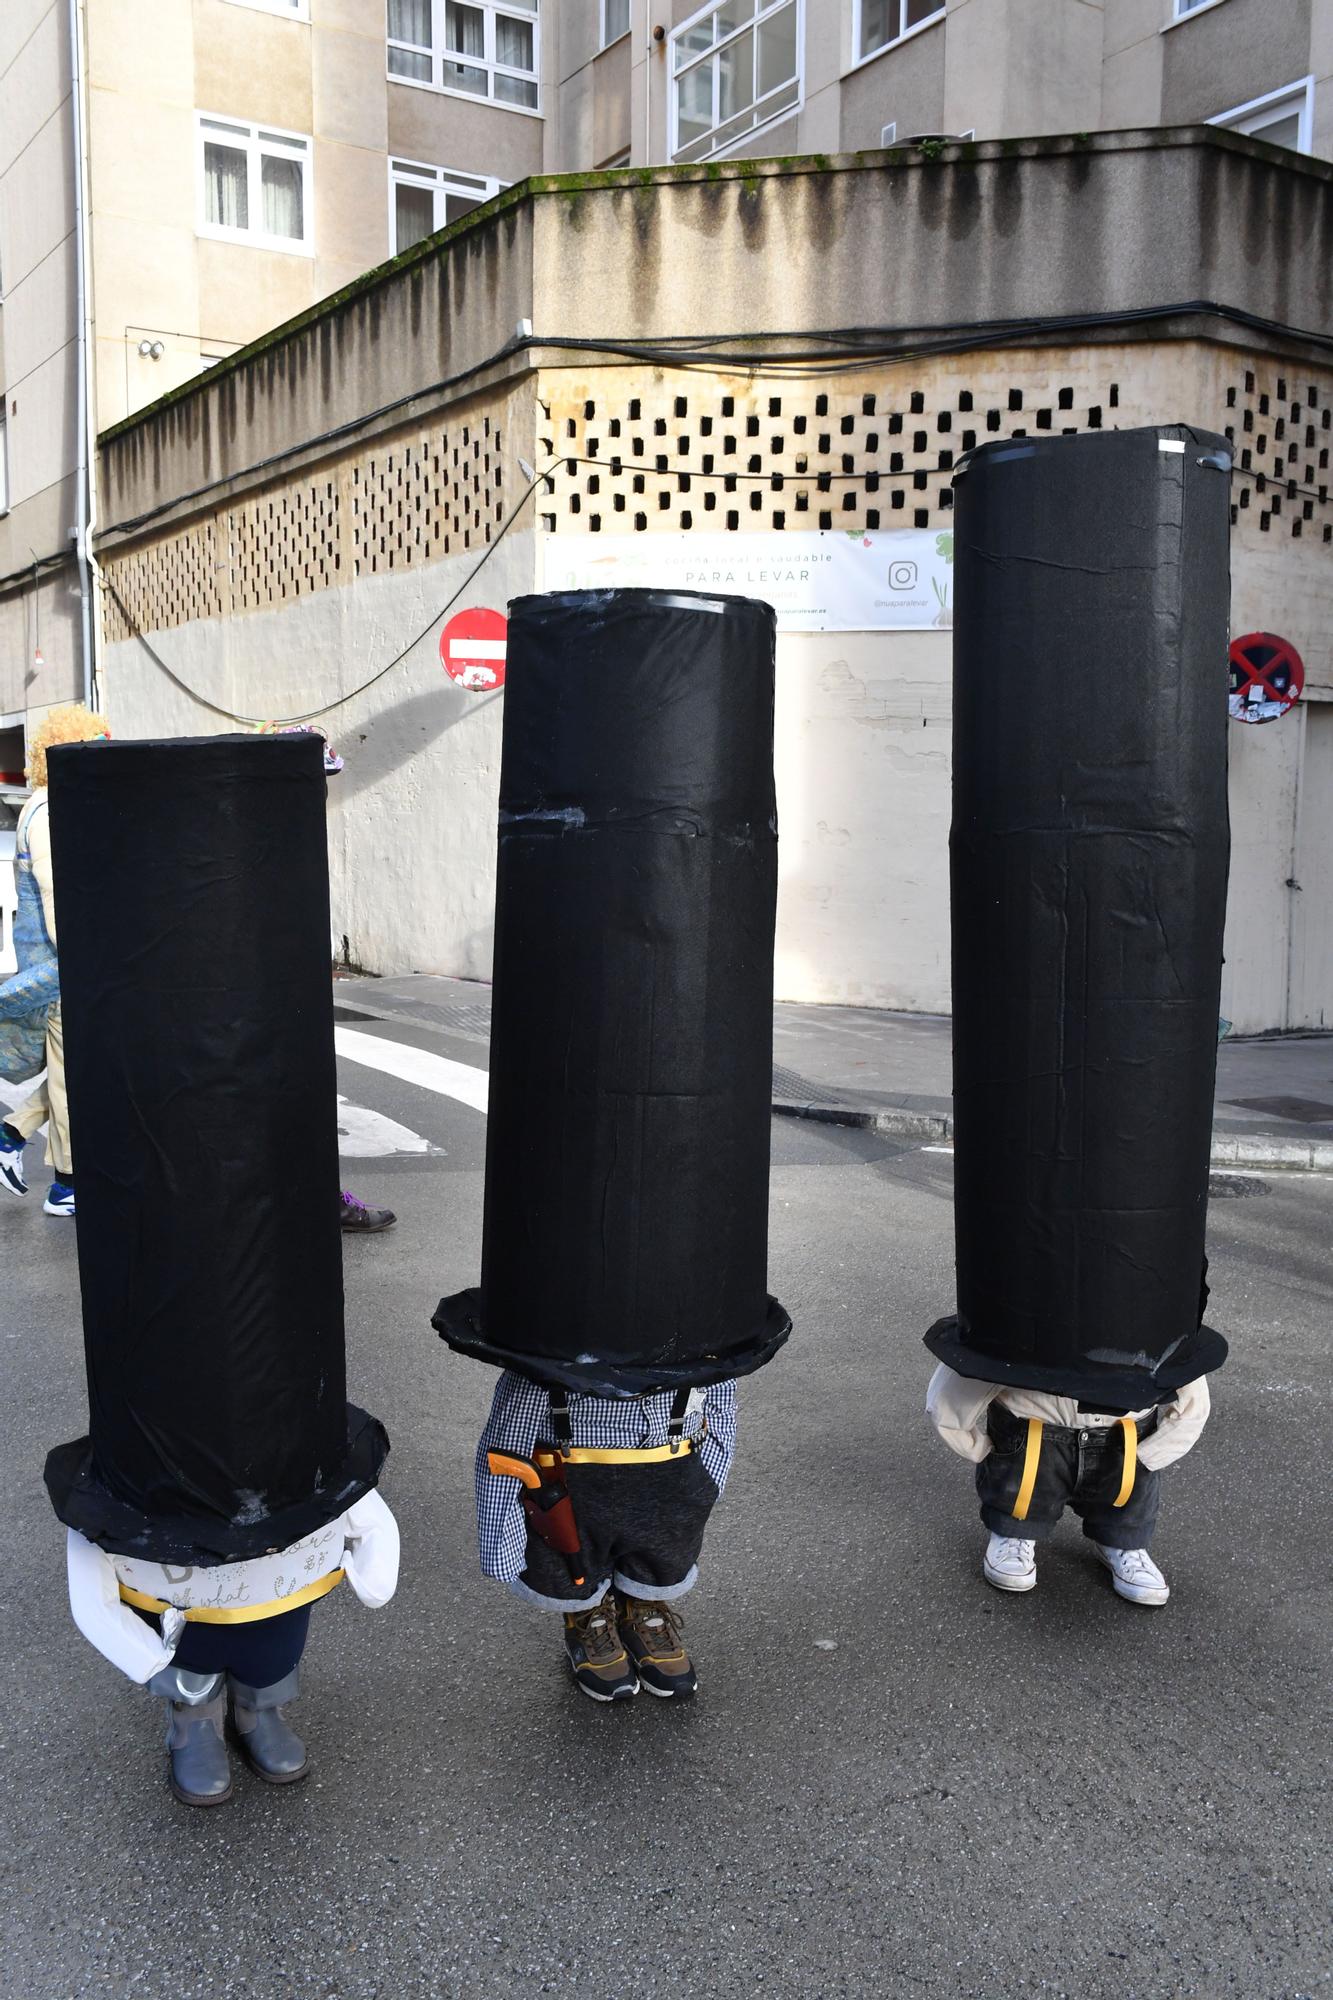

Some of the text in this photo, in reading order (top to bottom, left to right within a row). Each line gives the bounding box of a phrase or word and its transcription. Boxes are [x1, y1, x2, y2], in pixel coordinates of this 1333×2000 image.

[770, 553, 832, 563] saudable
[685, 570, 809, 582] PARA LEVAR
[201, 1584, 249, 1608] what
